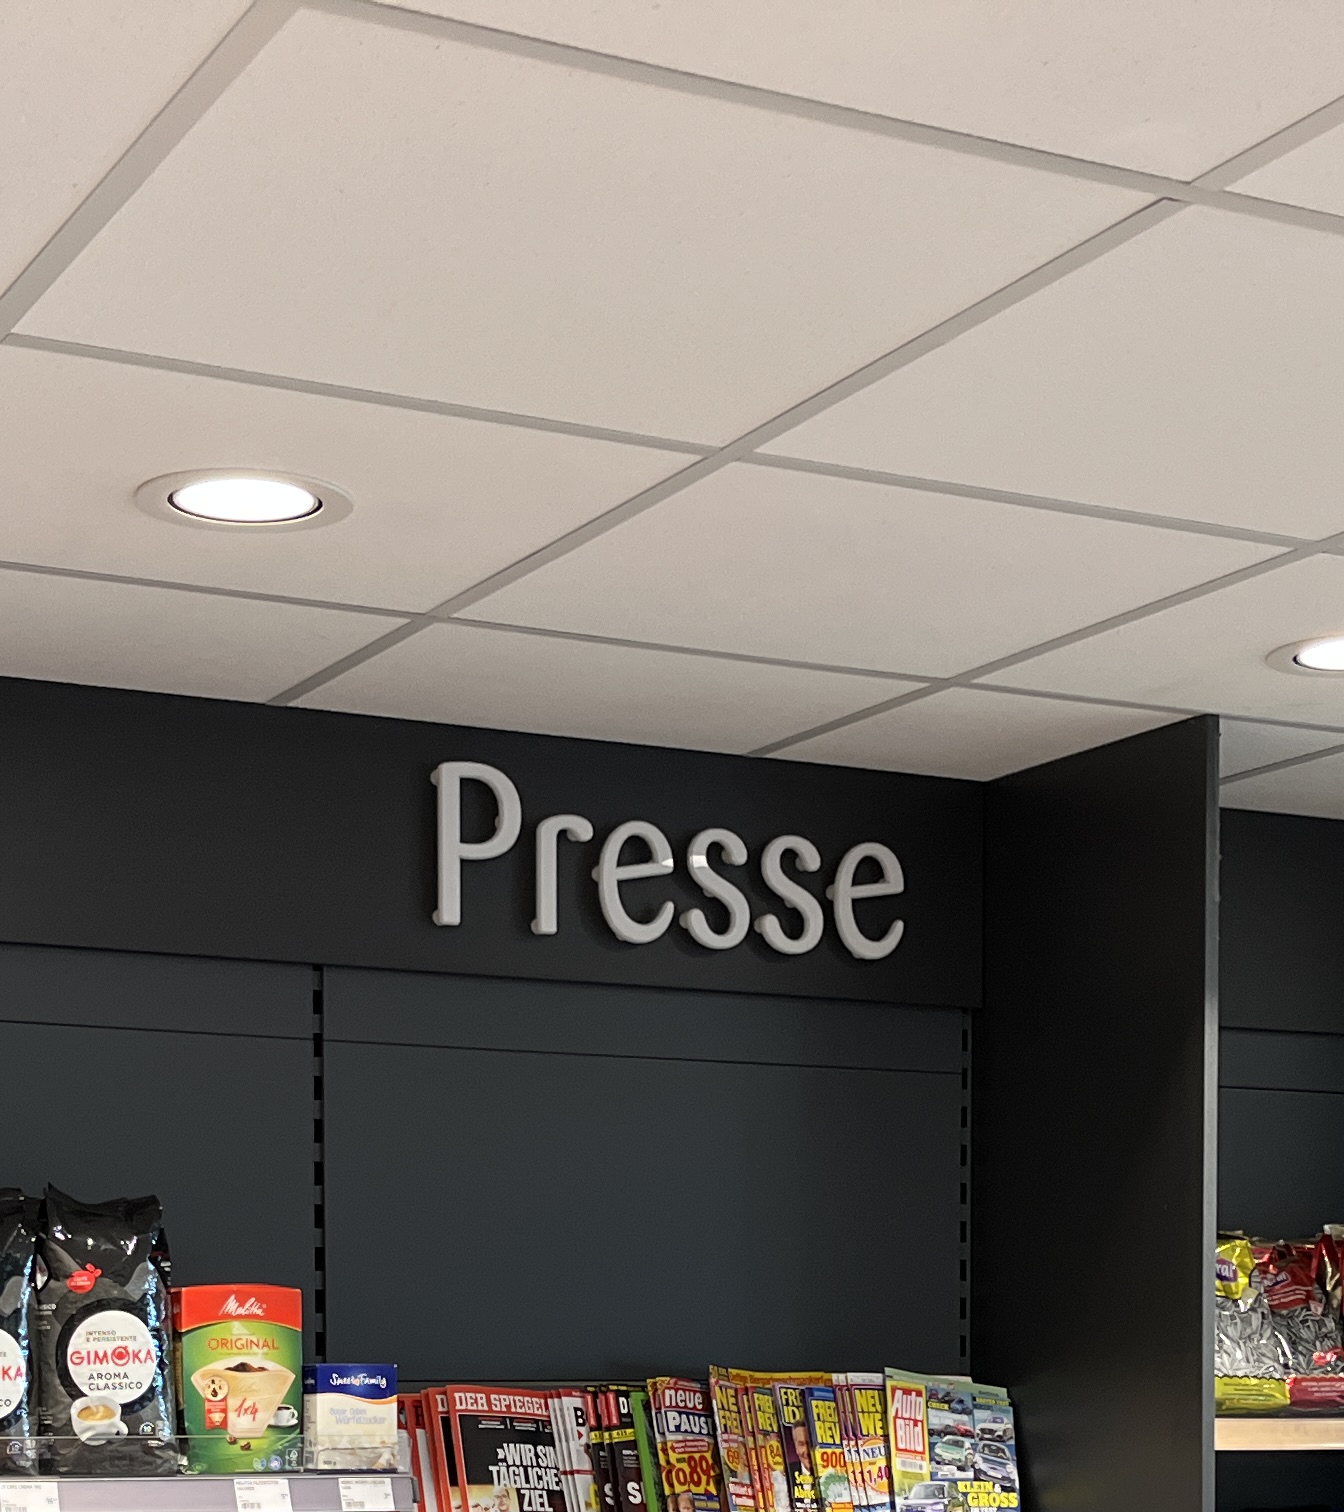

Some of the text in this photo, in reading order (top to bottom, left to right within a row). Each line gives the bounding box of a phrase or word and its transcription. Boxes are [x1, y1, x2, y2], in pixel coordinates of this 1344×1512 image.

[430, 761, 904, 960] Presse
[219, 1294, 266, 1318] Melitta
[208, 1336, 279, 1352] ORIGINAL
[70, 1346, 154, 1366] GIMOKA
[88, 1372, 129, 1381] AROMA
[88, 1381, 142, 1391] CLASSICO
[454, 1393, 548, 1415] DER SPIEGEL
[665, 1387, 703, 1408] neue
[892, 1386, 923, 1418] Auto
[896, 1415, 923, 1452] Bild
[958, 1481, 992, 1492] KLEIN
[520, 1490, 553, 1511] ZIEL
[968, 1492, 1017, 1507] GROSS
